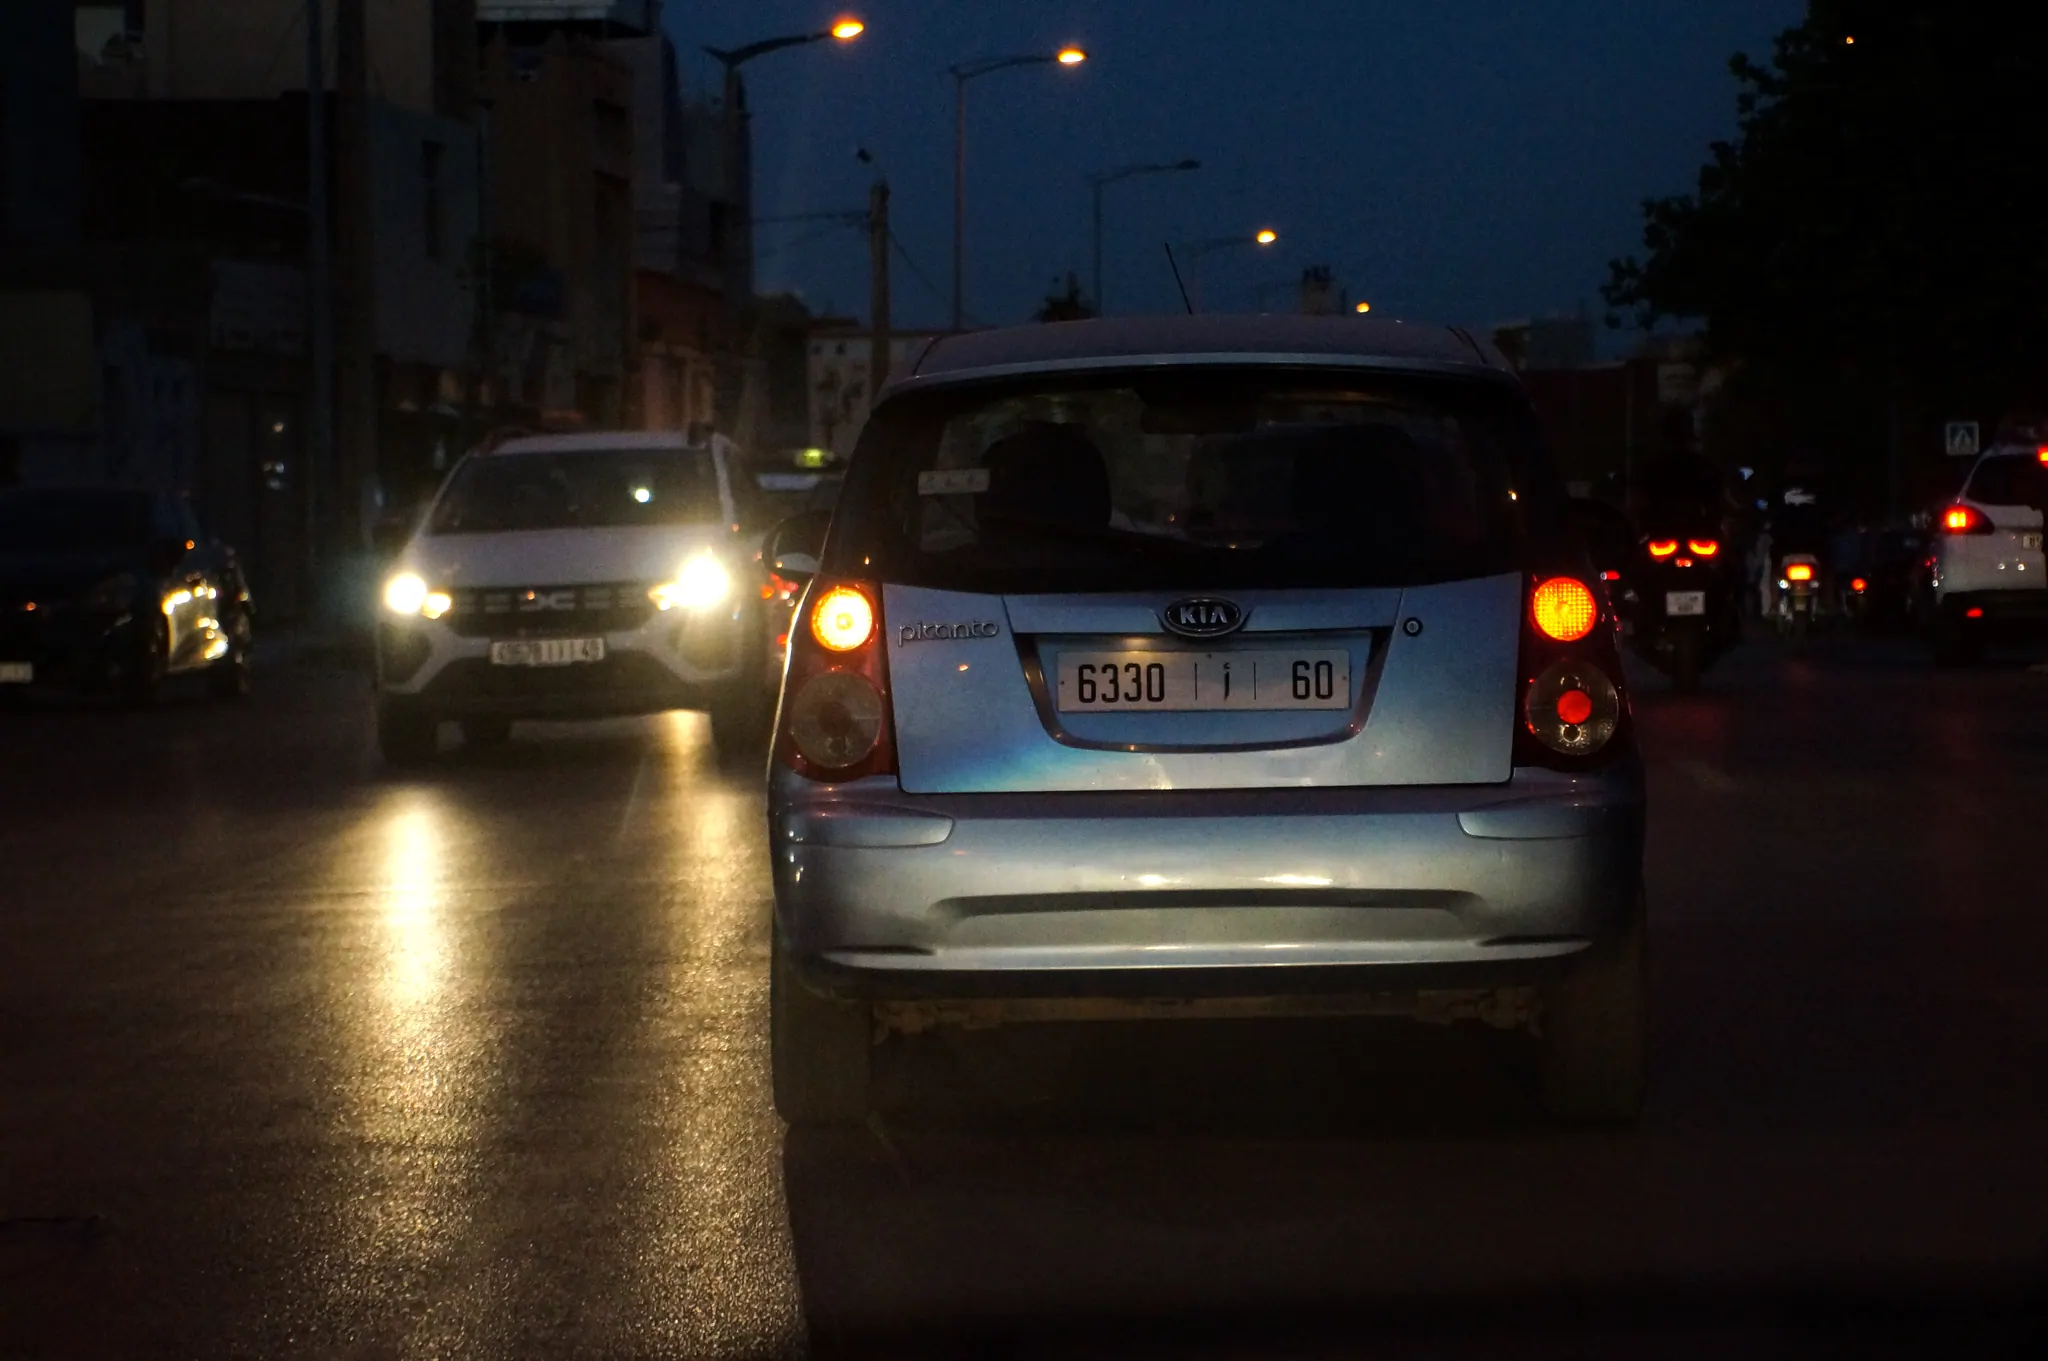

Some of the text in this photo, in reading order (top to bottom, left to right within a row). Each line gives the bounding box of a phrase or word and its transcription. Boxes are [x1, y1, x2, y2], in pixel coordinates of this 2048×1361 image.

[1180, 605, 1228, 625] KIA
[898, 620, 999, 648] picanto
[1078, 663, 1165, 703] 6330
[1292, 660, 1333, 700] 60
